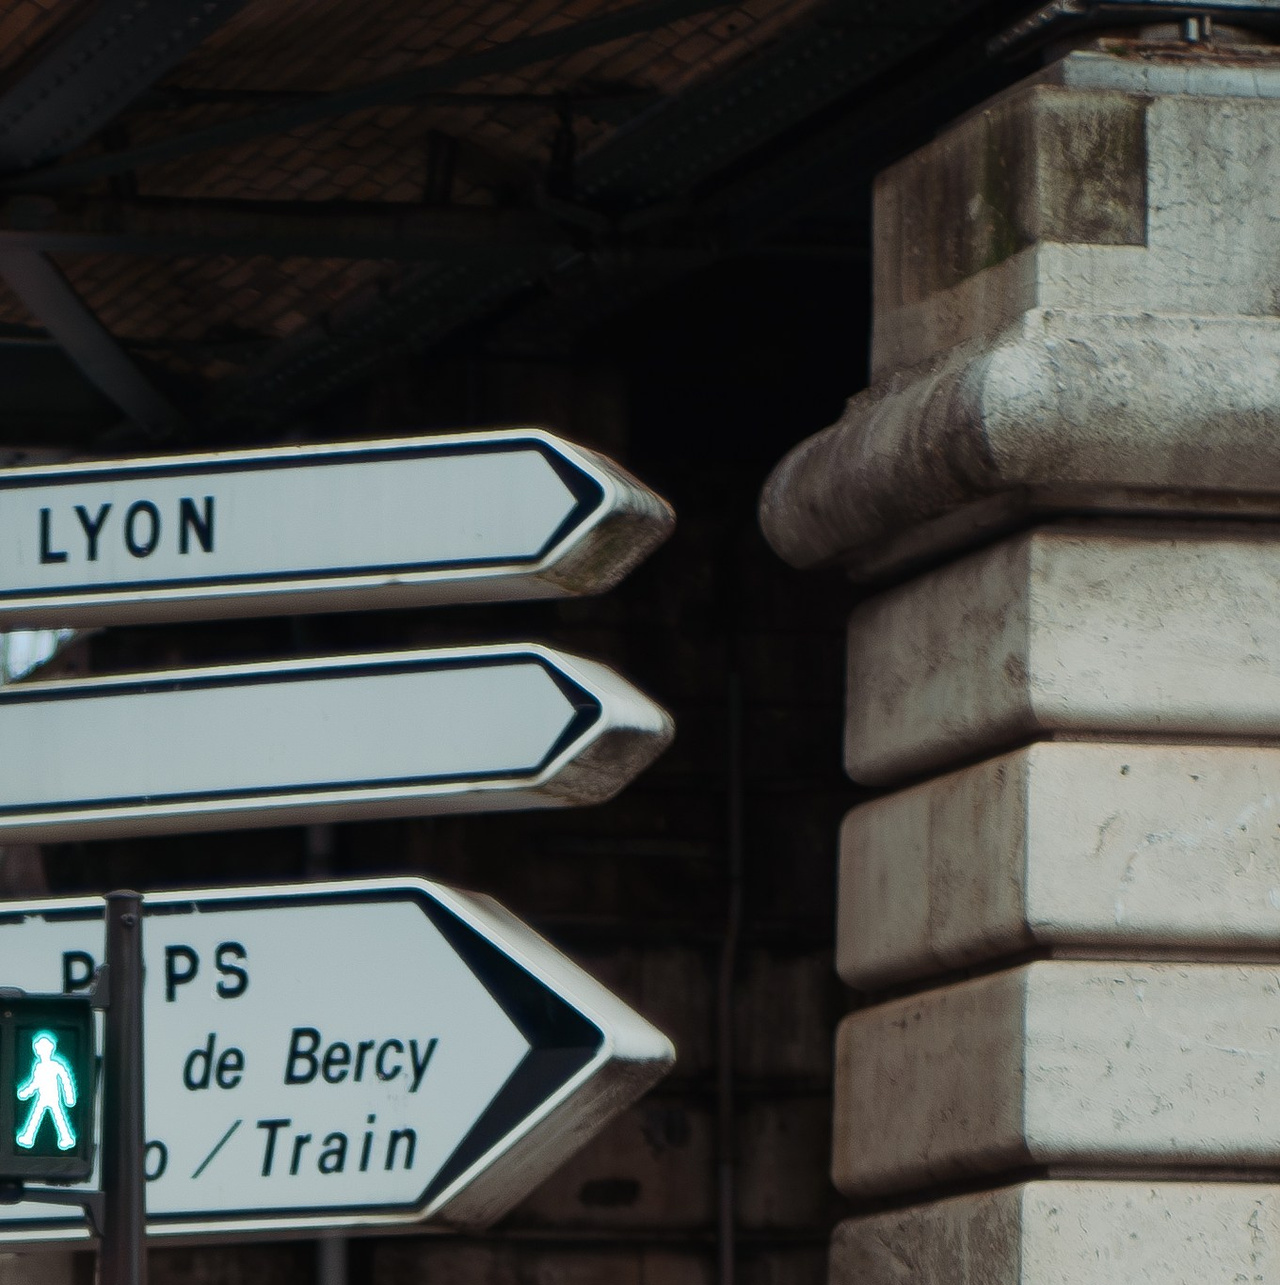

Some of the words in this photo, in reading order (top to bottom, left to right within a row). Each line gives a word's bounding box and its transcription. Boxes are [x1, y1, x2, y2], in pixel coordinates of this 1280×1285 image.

[39, 495, 216, 565] LYON
[62, 941, 249, 1003] PPS
[183, 1032, 245, 1092] de
[283, 1027, 439, 1093] Bercy
[256, 1113, 417, 1178] Train
